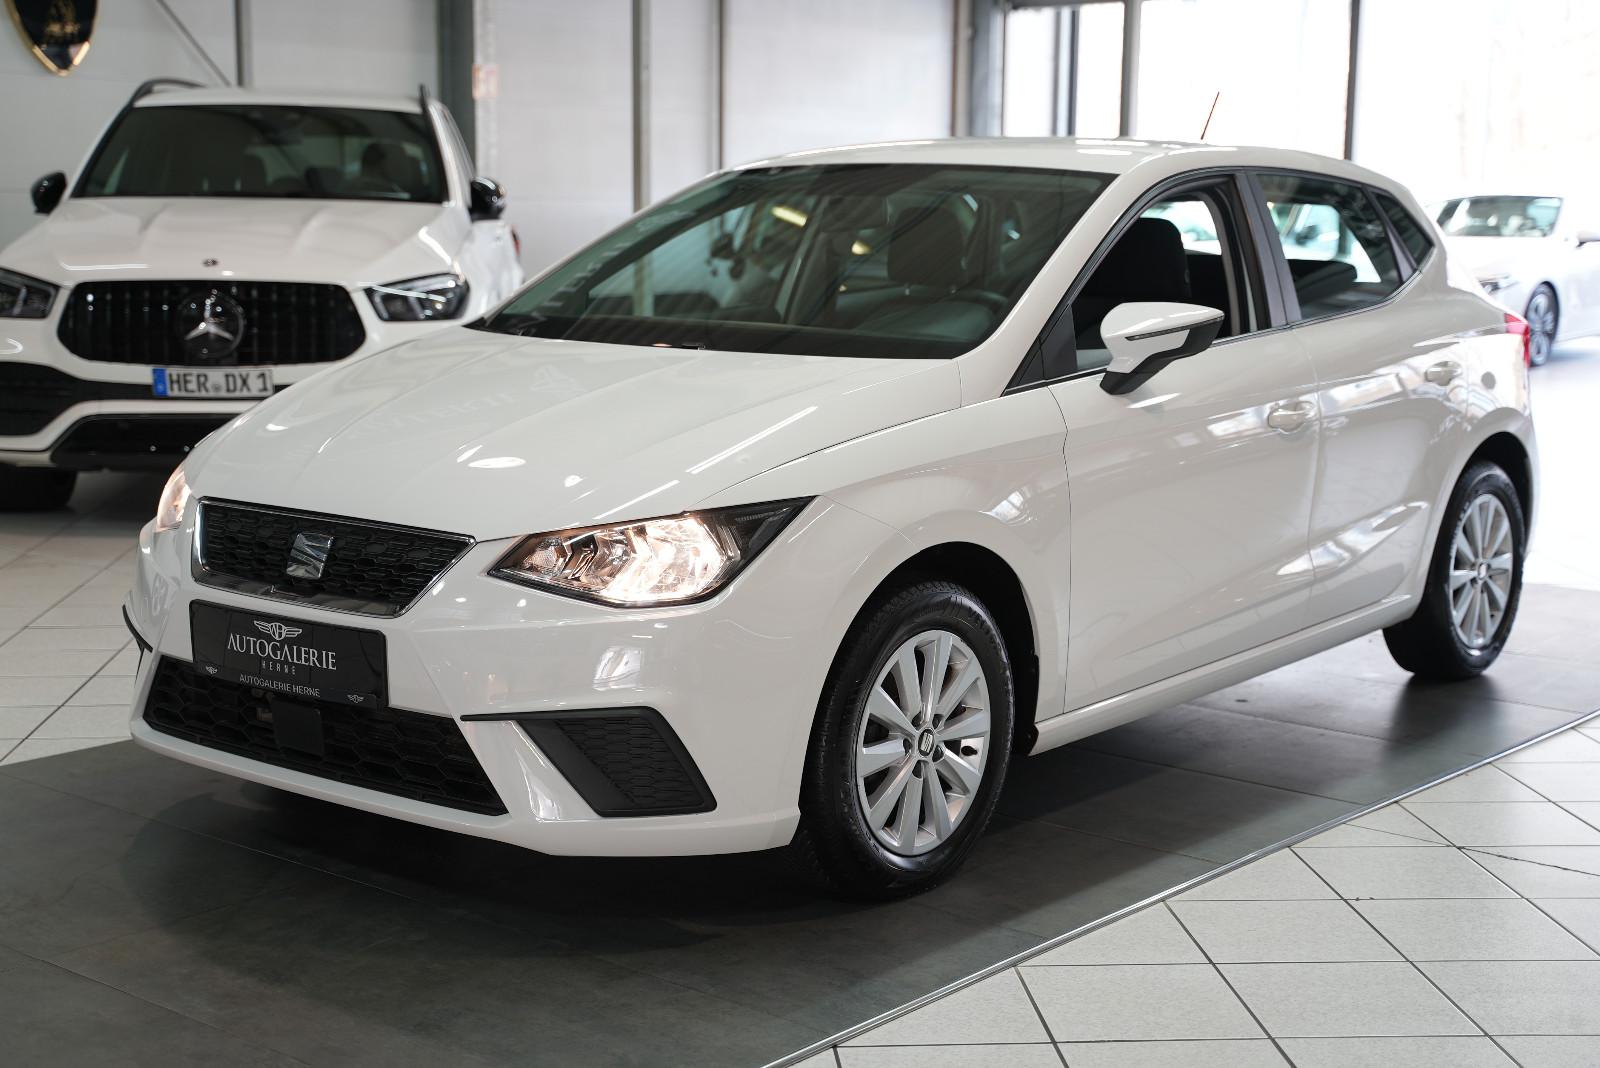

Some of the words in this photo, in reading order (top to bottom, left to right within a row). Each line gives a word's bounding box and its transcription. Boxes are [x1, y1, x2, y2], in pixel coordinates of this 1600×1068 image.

[168, 373, 209, 393] HER
[225, 373, 251, 393] DX
[257, 372, 269, 392] 1
[227, 633, 337, 671] AUTOGALERIE
[261, 660, 296, 675] HERNE
[240, 674, 292, 692] AUTOGALERIE
[292, 684, 321, 698] HERNE
